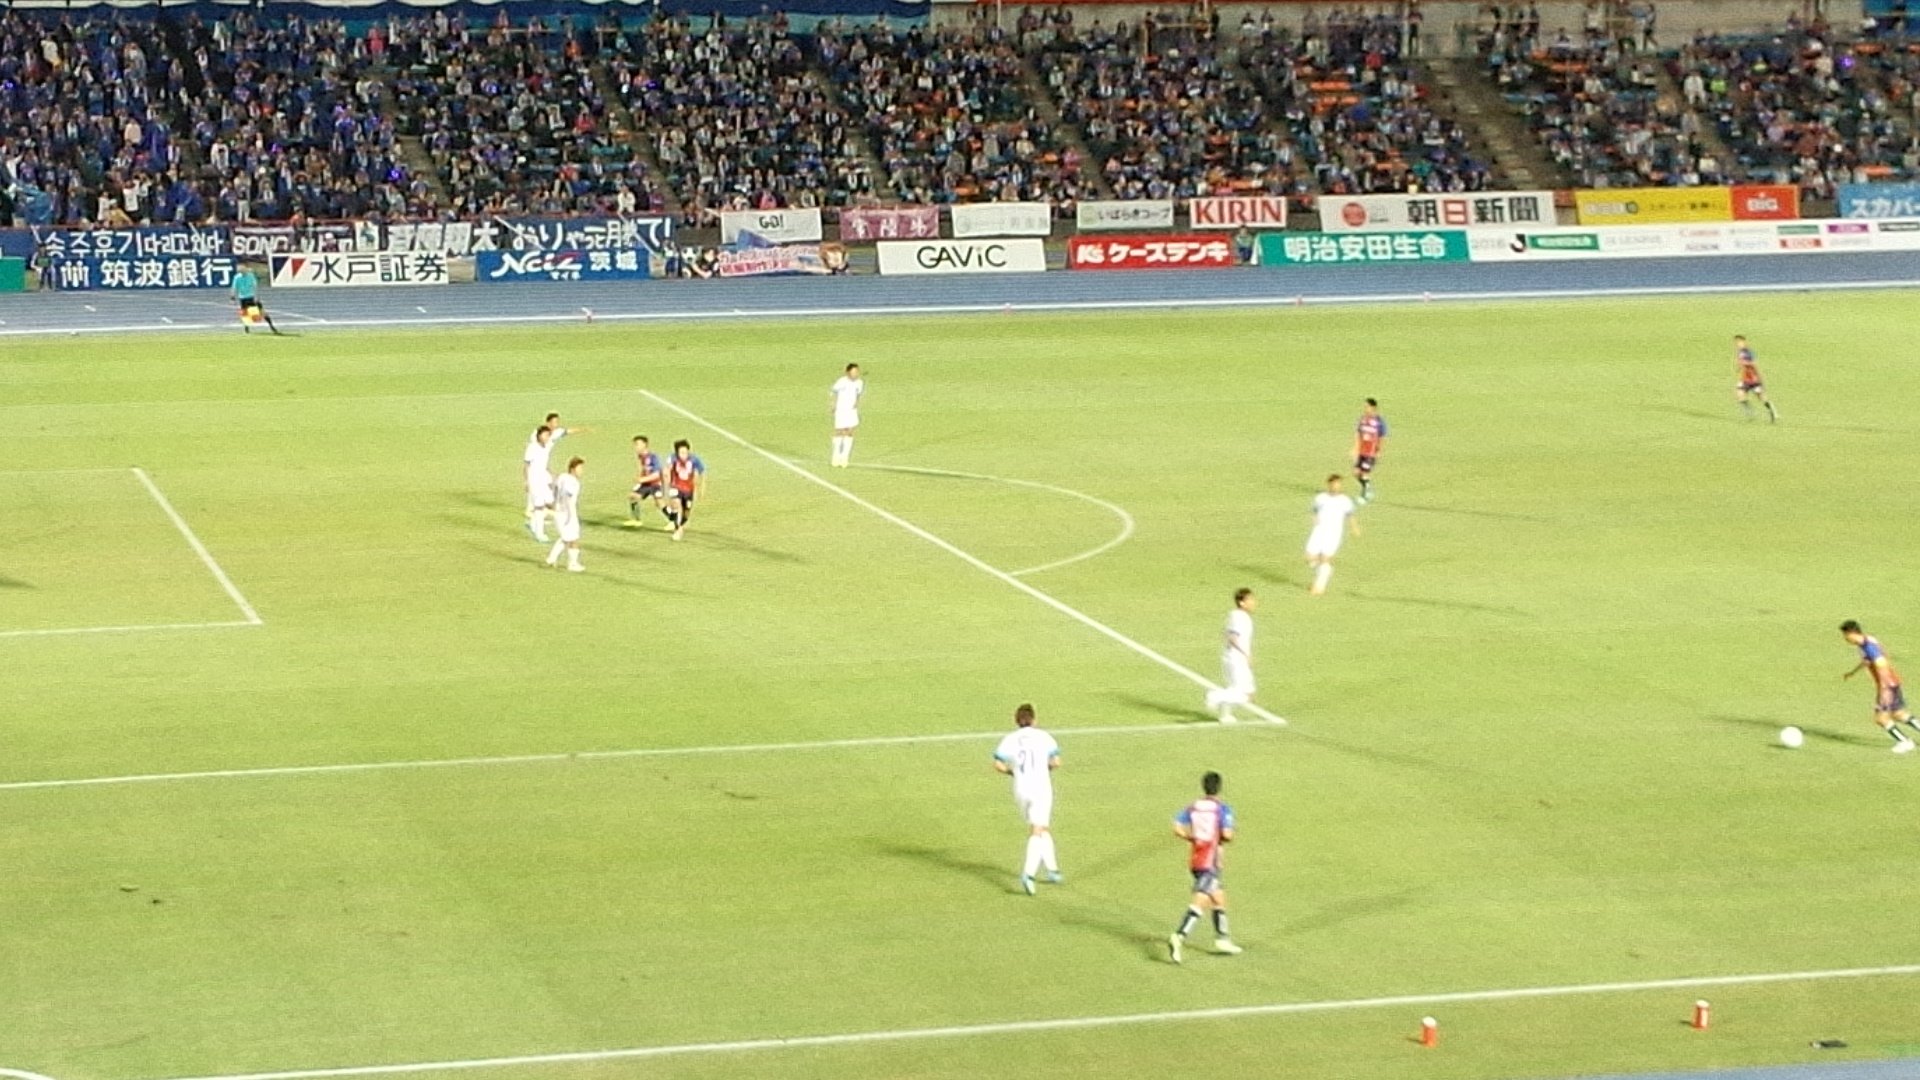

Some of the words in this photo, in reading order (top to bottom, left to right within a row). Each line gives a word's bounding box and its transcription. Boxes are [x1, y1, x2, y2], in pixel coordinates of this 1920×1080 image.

[1195, 199, 1283, 224] KIRIN
[1407, 196, 1539, 224] 朝日新聞
[1108, 241, 1229, 263] ケーズデンキ
[1284, 236, 1446, 261] 明治安田生命
[101, 258, 233, 287] 筑波銀行
[311, 253, 446, 283] 水戸証券
